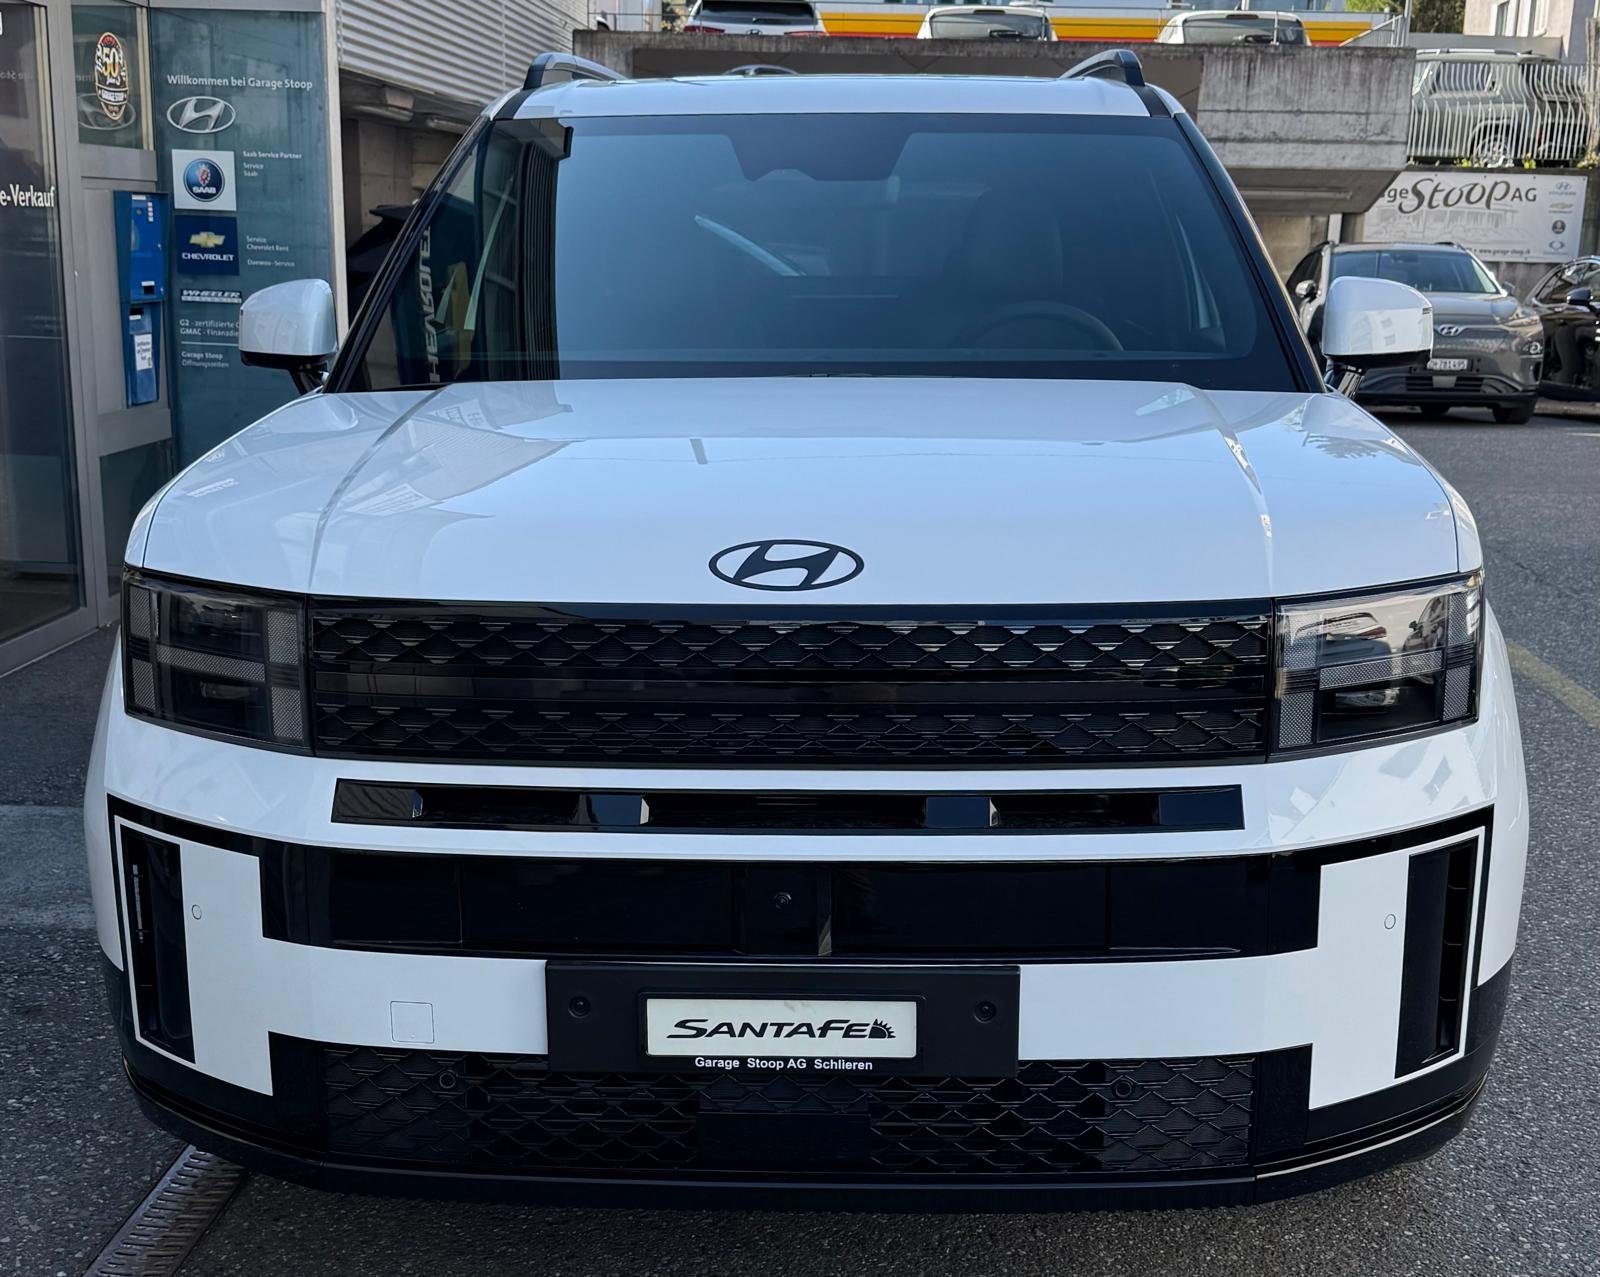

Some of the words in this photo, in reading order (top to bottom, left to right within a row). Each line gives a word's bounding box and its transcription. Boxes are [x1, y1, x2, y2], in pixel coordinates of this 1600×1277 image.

[103, 47, 119, 78] 50
[167, 75, 229, 86] Willkommen
[231, 77, 246, 86] bei
[248, 78, 283, 90] Garage
[285, 79, 313, 91] Stoop
[258, 151, 279, 159] Service
[192, 186, 217, 194] SAAB
[1511, 187, 1537, 202] AG
[181, 252, 235, 261] CHEVROLET
[182, 289, 241, 298] WHEELER
[179, 318, 190, 326] G2
[195, 320, 235, 328] zertifizierte
[181, 352, 204, 360] Garage
[695, 1057, 740, 1070] Garage
[747, 1057, 785, 1071] Stoop
[787, 1058, 807, 1070] AG
[814, 1058, 873, 1071] Schlieren
